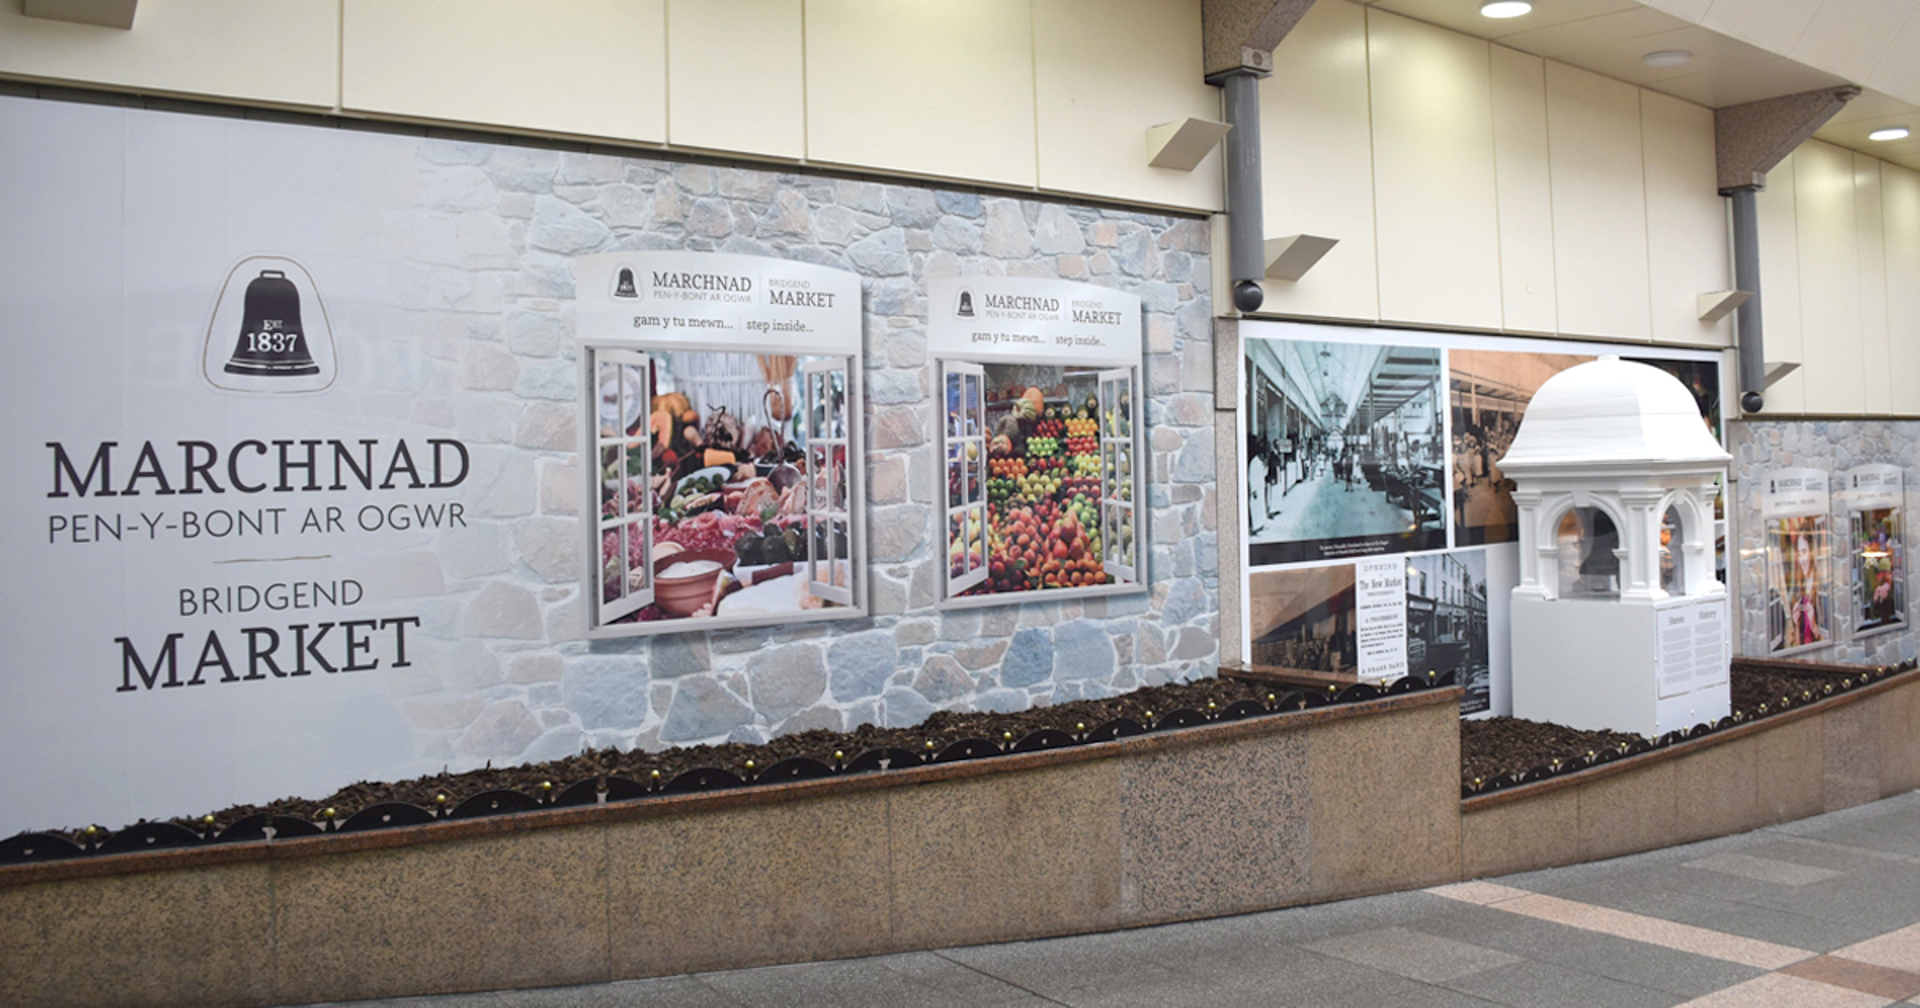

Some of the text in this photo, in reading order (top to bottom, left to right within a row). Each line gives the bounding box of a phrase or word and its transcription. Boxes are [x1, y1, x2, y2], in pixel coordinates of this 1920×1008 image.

[652, 271, 752, 292] MARCHNAD
[769, 279, 810, 289] BRIDGEND
[710, 294, 722, 302] AR
[723, 294, 752, 303] OGWR
[769, 289, 835, 308] MARKET
[985, 294, 1060, 312] MARCHNAD
[633, 314, 733, 329] gam y tu mewn...
[746, 319, 814, 333] step inside...
[1072, 309, 1122, 325] MARKET
[247, 332, 298, 353] 1837
[971, 332, 992, 343] gam
[993, 333, 999, 344] y
[1056, 336, 1073, 347] step
[45, 438, 471, 499] MARCHNAD
[49, 502, 468, 544] PEN-Y-BONT AR OGWR
[179, 579, 363, 616] BRIDGEND
[114, 616, 420, 693] MARKET
